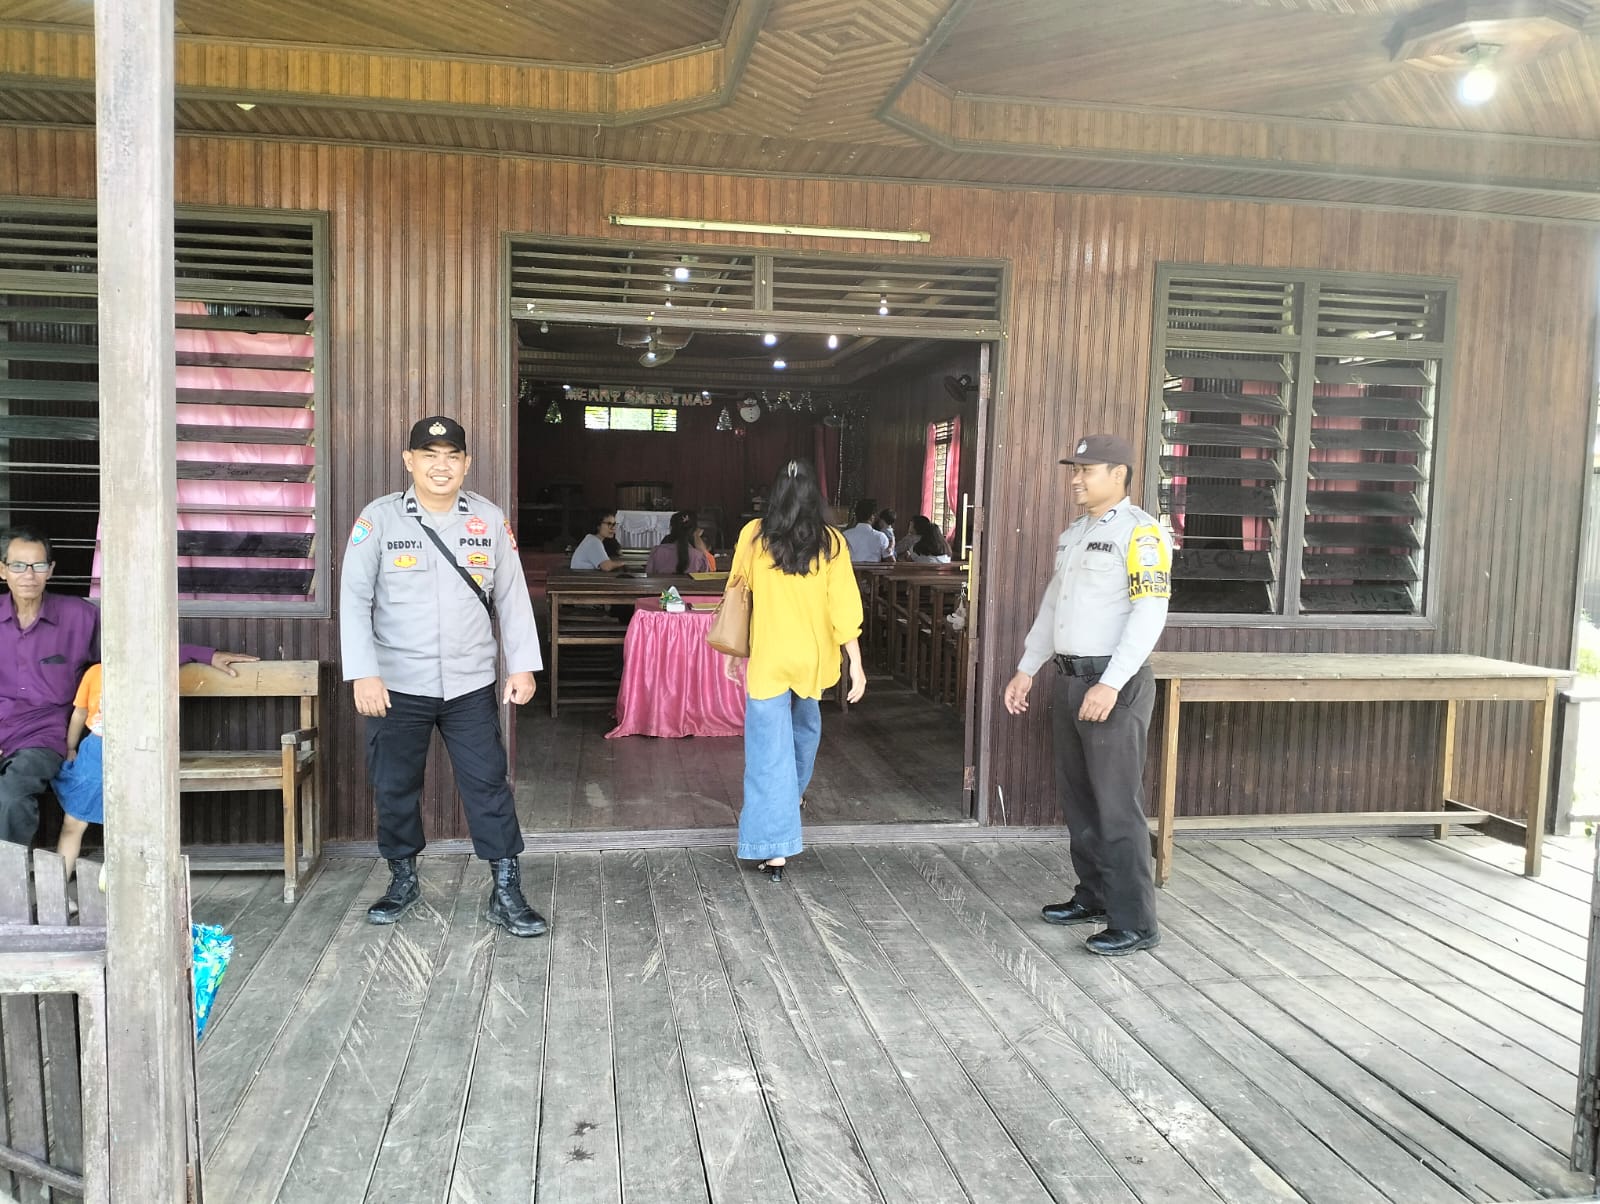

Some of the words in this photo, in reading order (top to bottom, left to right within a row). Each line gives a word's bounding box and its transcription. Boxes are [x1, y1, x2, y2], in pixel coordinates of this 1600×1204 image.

[564, 387, 621, 402] MERRY
[387, 541, 423, 550] DEDDY.I
[459, 537, 492, 548] POLRI
[1086, 541, 1113, 553] POLRI
